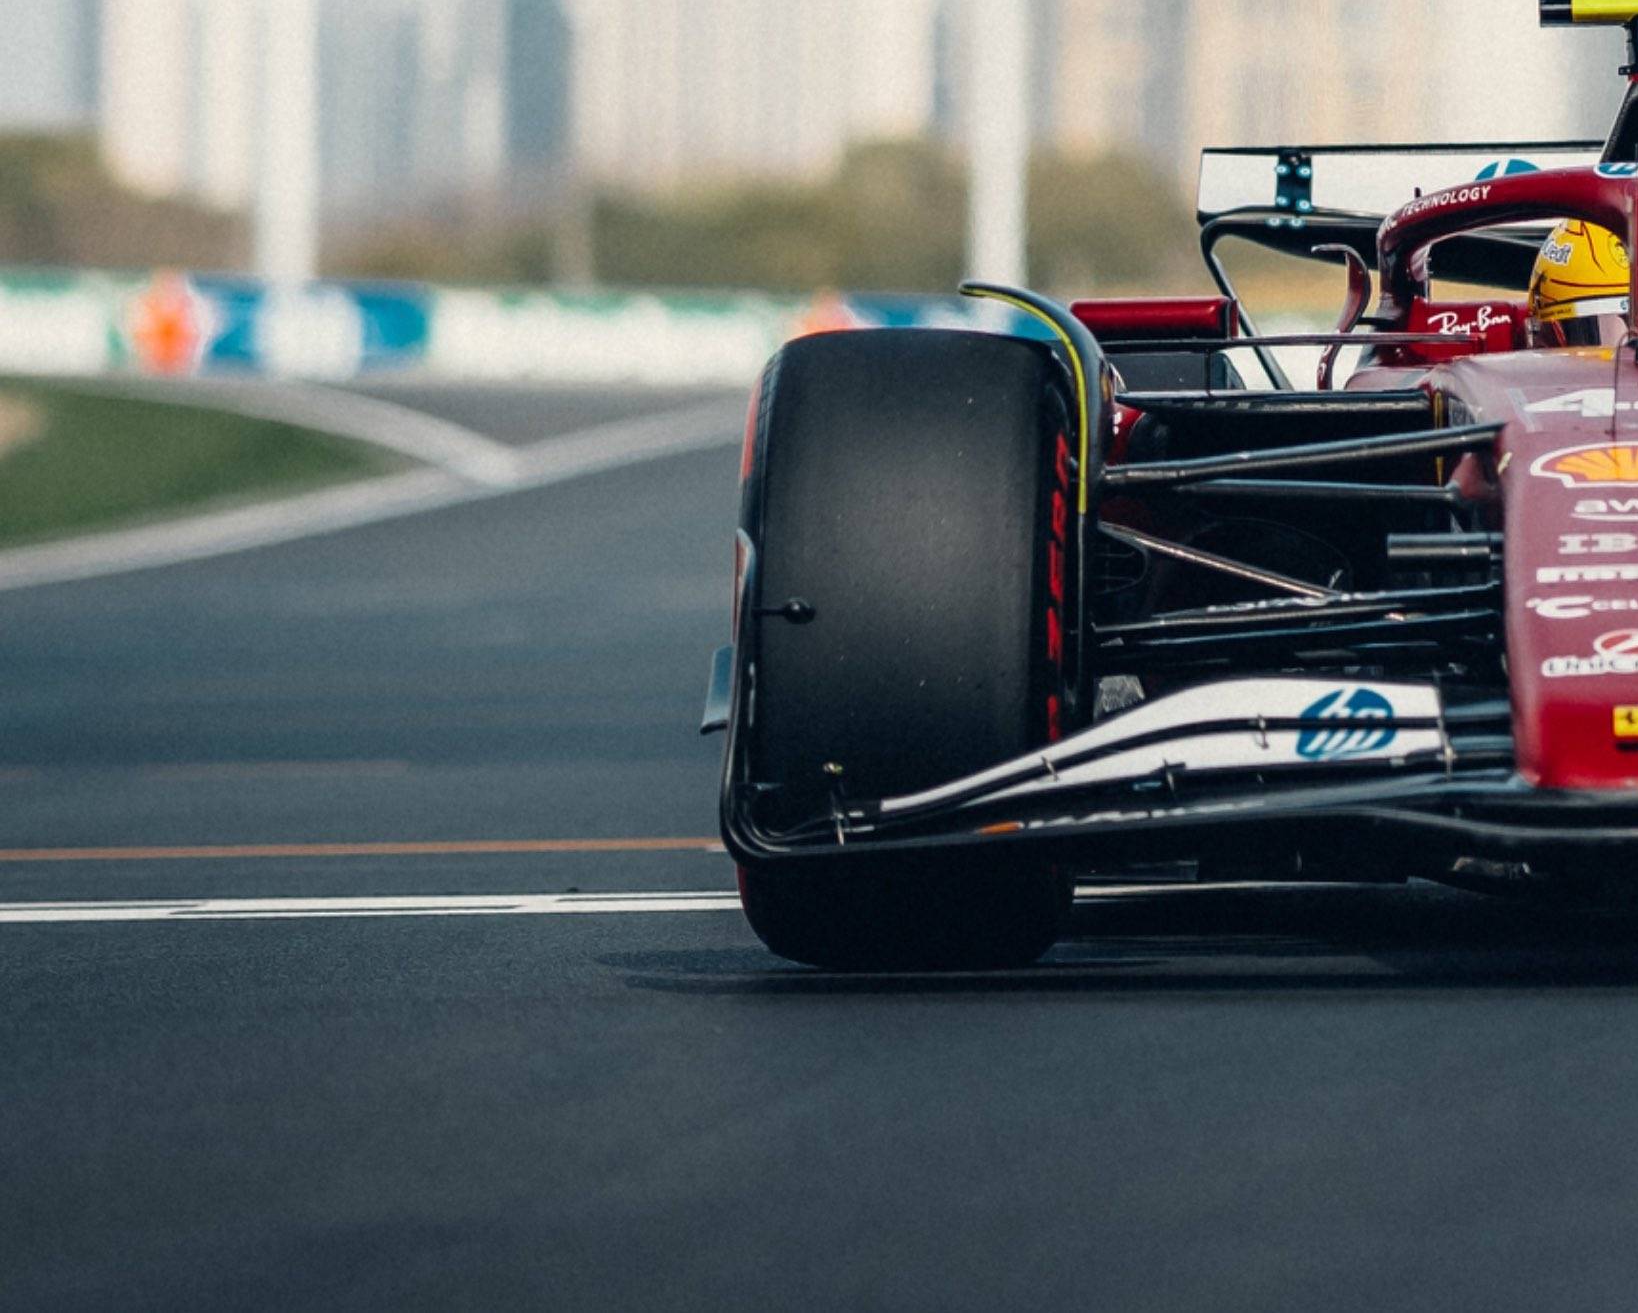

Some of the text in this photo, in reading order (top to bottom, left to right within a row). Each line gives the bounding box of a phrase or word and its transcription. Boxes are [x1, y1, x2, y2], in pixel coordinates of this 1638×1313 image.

[1402, 185, 1492, 217] TECHNOLOGY
[1427, 305, 1512, 336] Ray-Ban
[1299, 687, 1394, 761] hp
